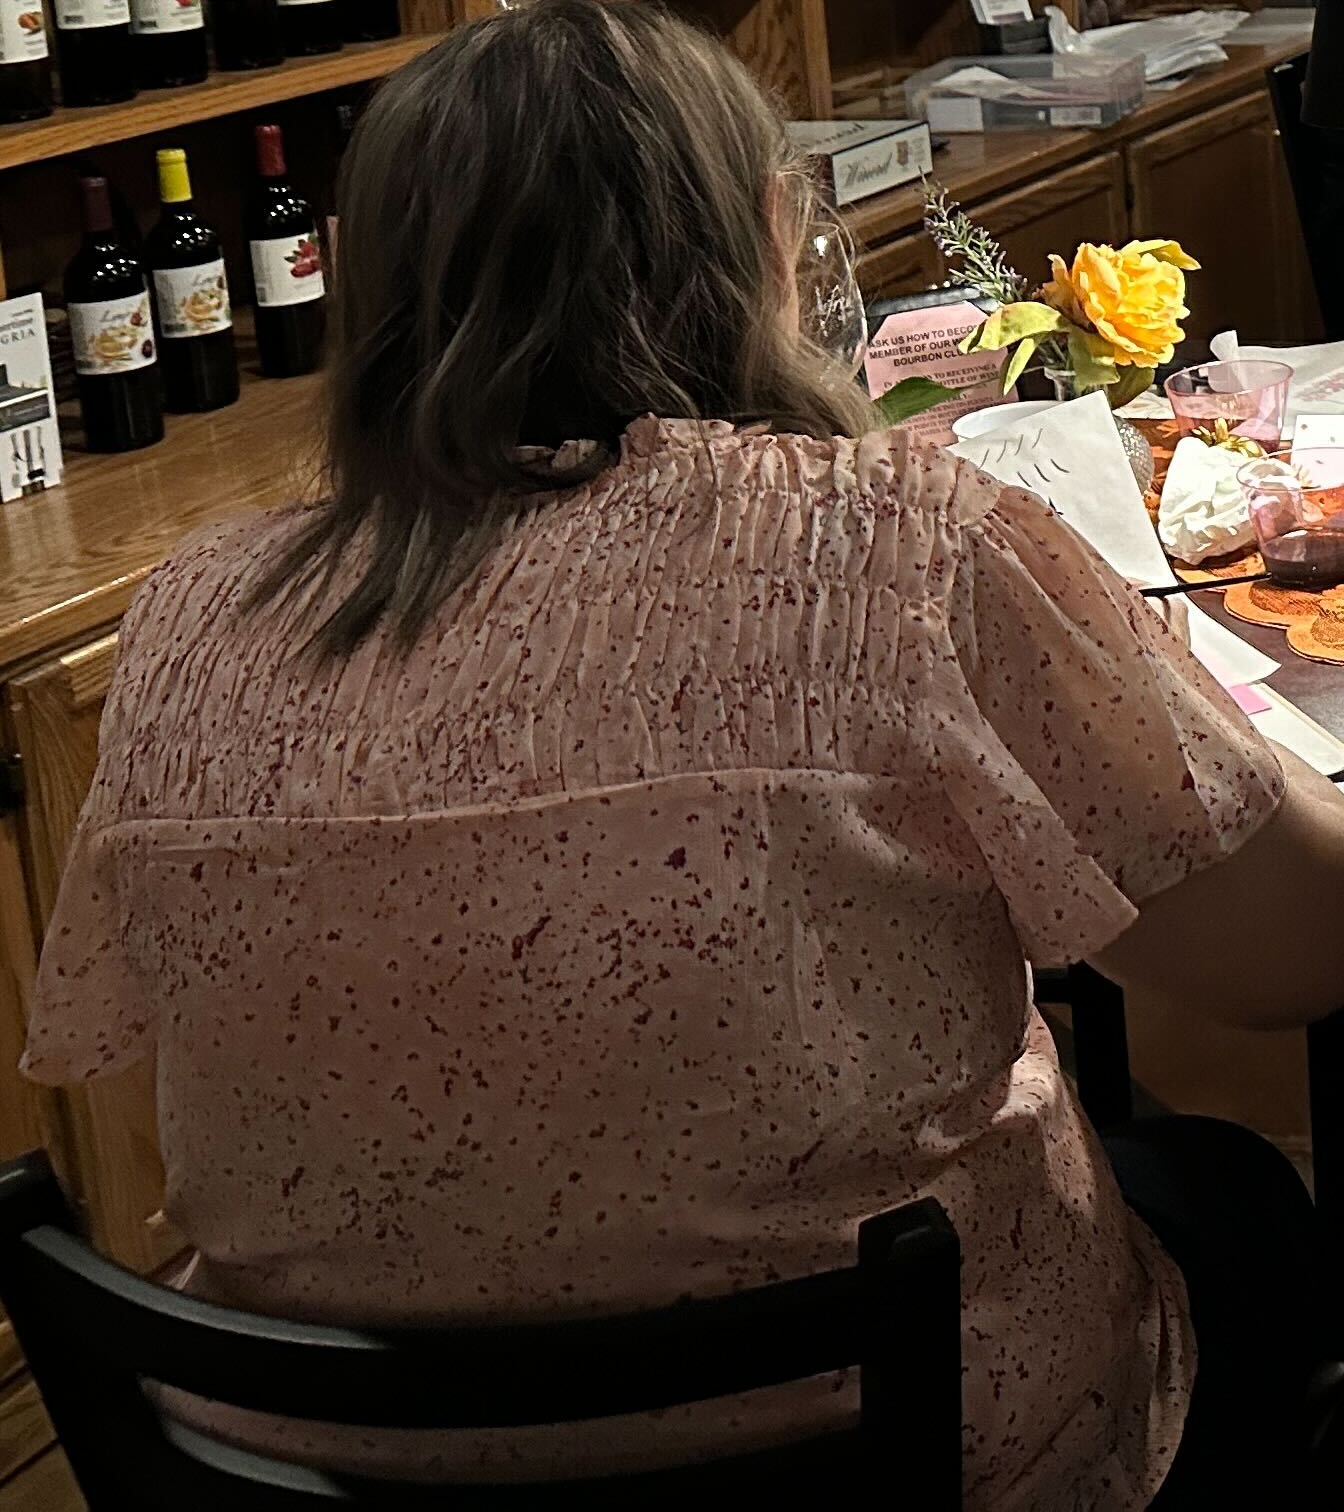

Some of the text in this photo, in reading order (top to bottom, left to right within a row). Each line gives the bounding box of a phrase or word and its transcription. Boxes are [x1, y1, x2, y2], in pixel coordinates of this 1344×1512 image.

[868, 324, 978, 349] ASK US HOW TO BECO
[869, 345, 912, 360] MEMBER
[914, 342, 928, 354] OF
[929, 339, 952, 353] OUR
[893, 352, 943, 367] BOURBON
